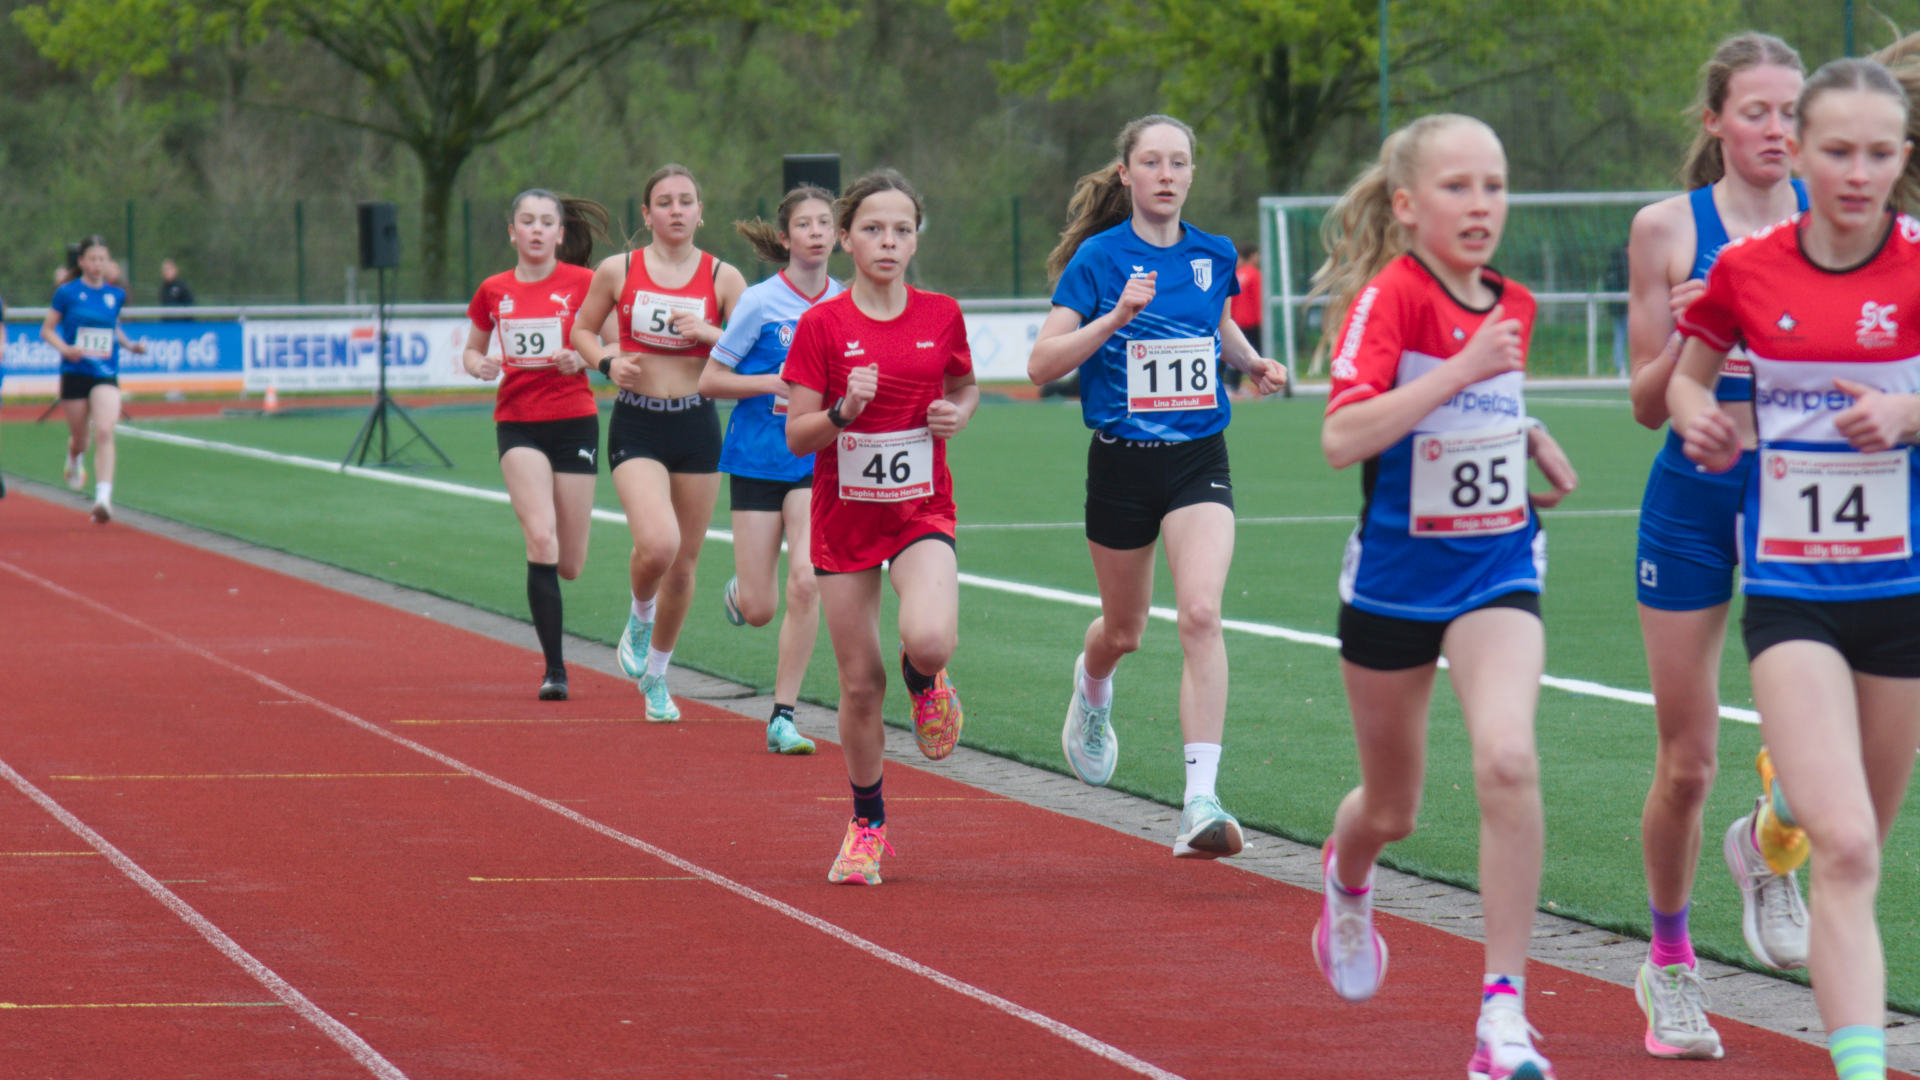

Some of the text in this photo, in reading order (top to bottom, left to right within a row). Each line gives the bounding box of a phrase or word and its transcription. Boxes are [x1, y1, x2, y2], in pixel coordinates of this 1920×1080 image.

[514, 332, 545, 356] 39
[1143, 358, 1208, 393] 118
[1153, 400, 1170, 408] Lina
[862, 450, 911, 485] 46
[1451, 456, 1510, 507] 85
[848, 488, 875, 497] Sophie
[876, 489, 899, 498] Marie
[1799, 483, 1871, 533] 14
